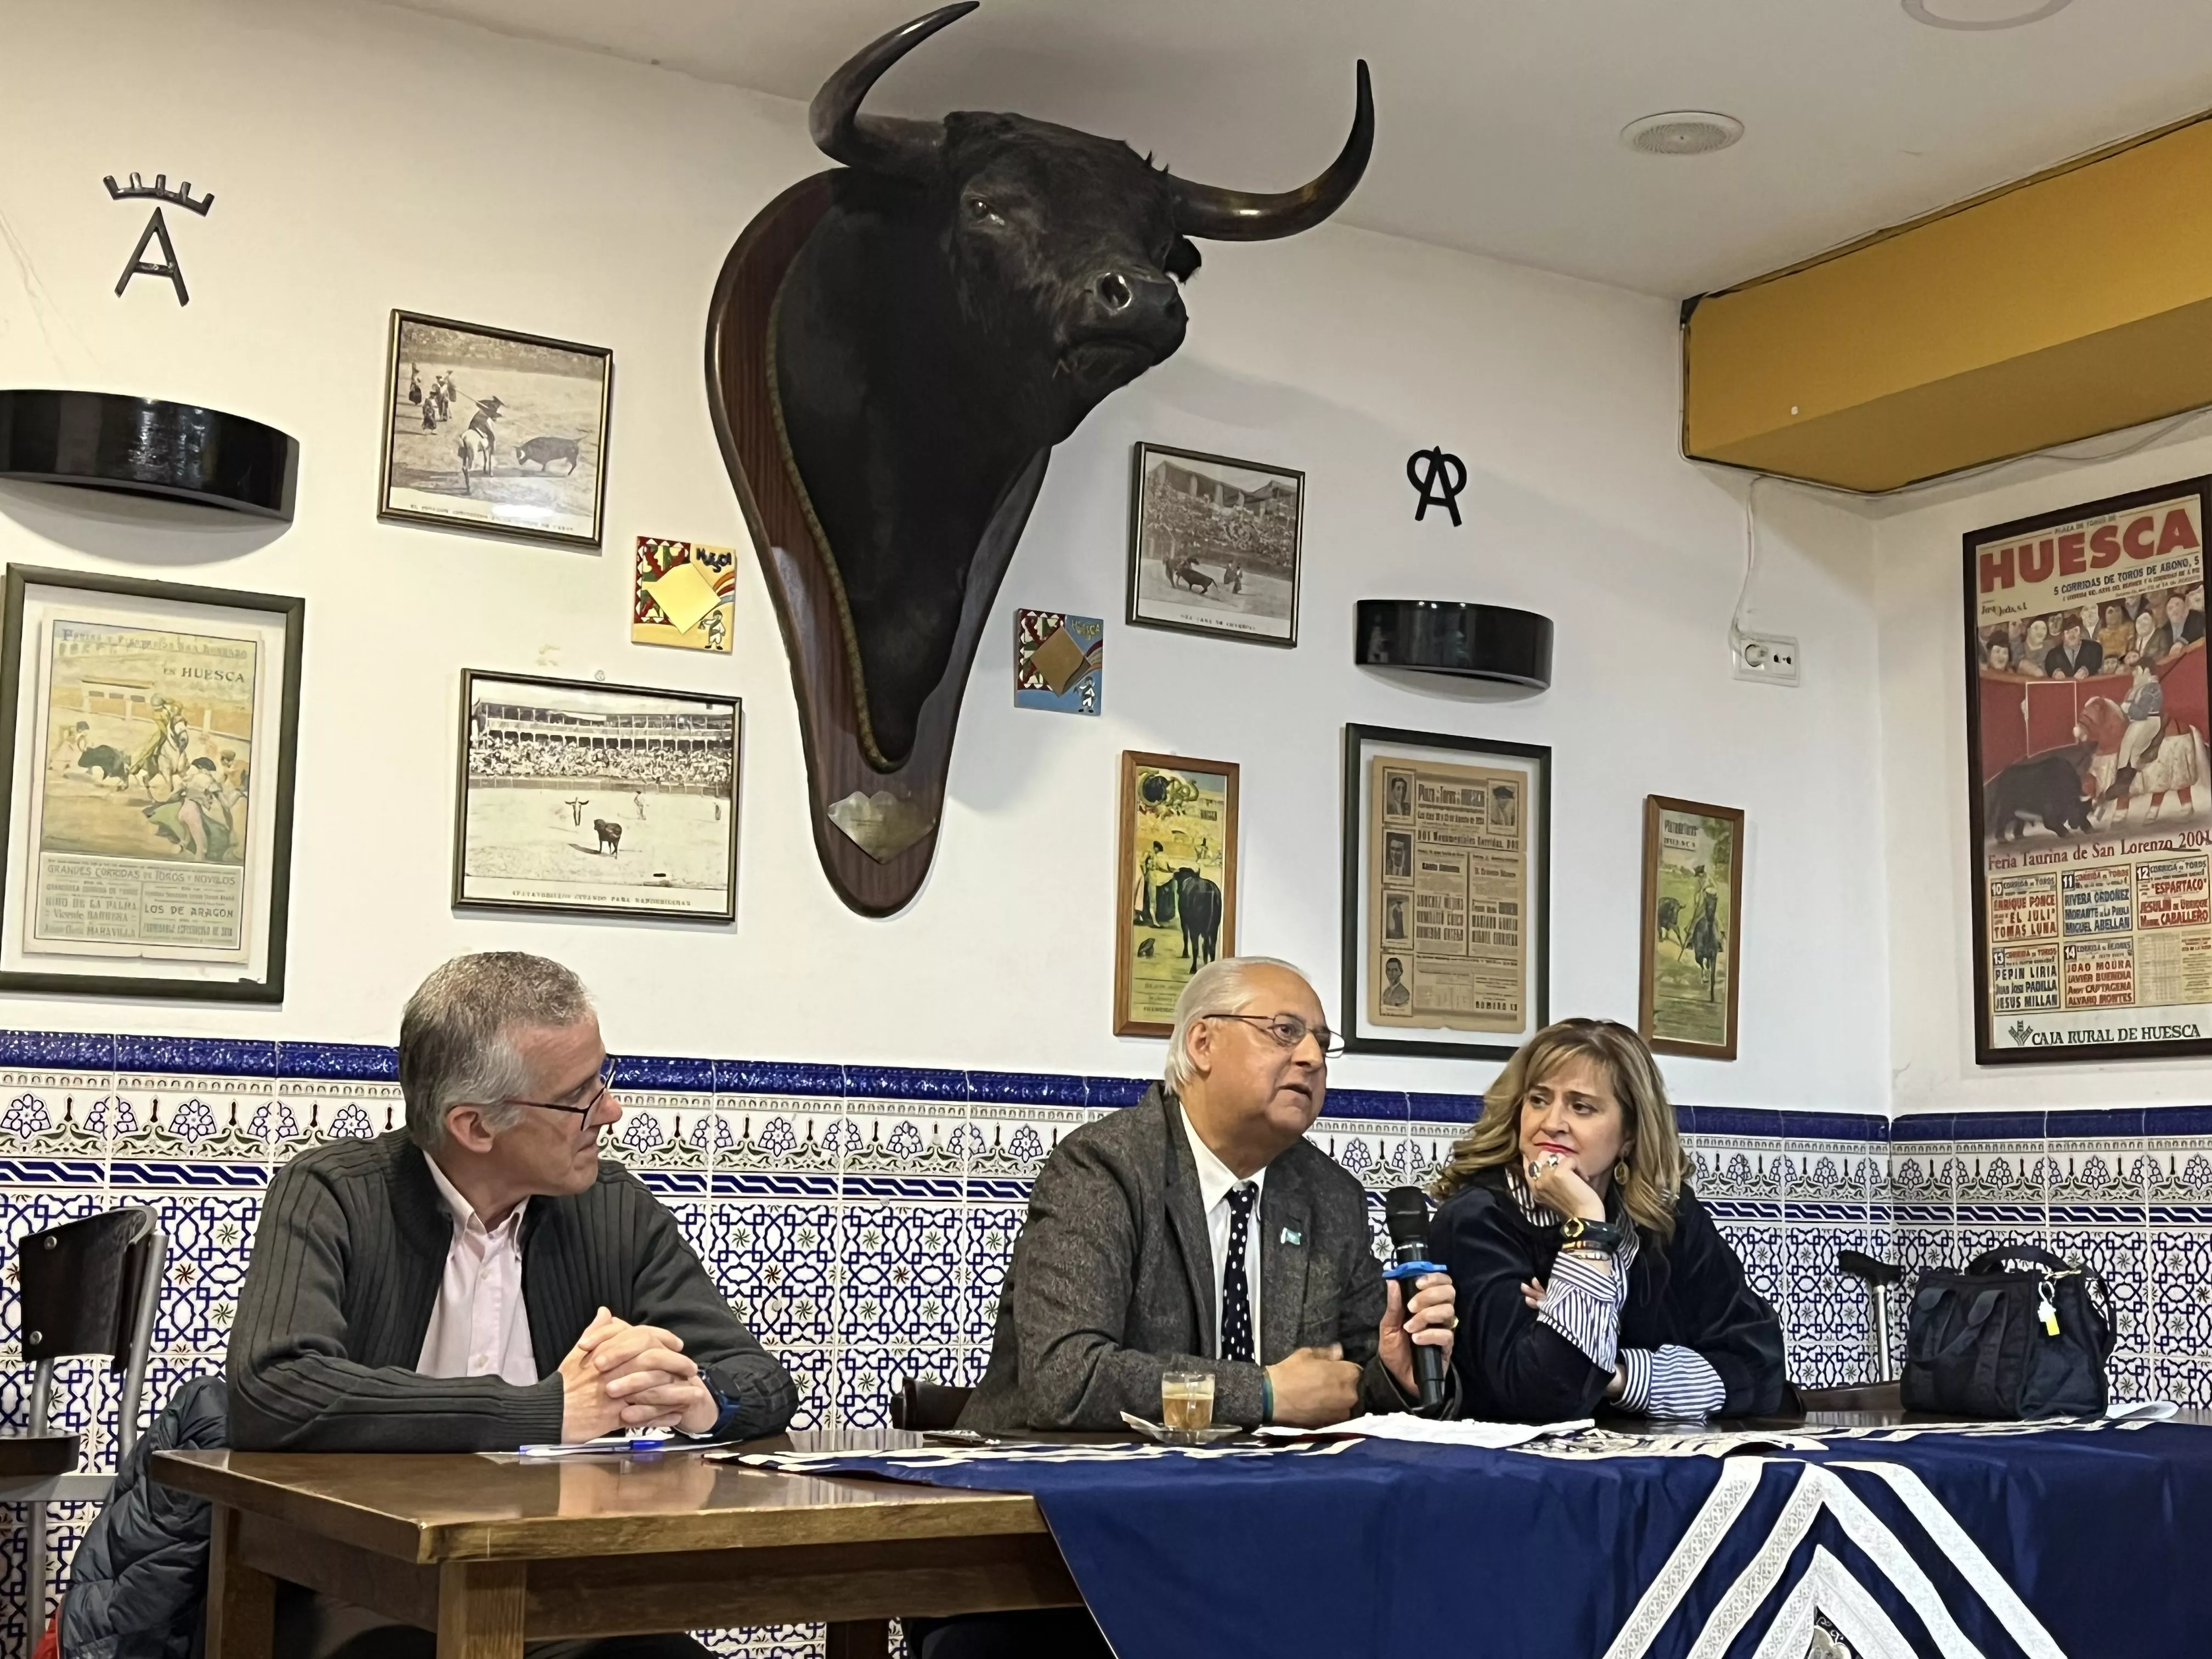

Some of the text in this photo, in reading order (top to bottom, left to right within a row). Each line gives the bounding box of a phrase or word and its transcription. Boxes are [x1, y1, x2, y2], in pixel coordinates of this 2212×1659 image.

[1979, 508, 2200, 593] HUESCA
[2061, 577, 2101, 594] CORRIDAS
[2104, 574, 2115, 585] DE
[2117, 568, 2143, 582] TOROS
[2146, 565, 2157, 575] DE
[181, 667, 244, 683] HUESCA
[1989, 854, 2017, 871] Feria
[2022, 848, 2068, 866] Taurina
[2073, 844, 2088, 860] de
[2091, 842, 2114, 858] San
[2121, 838, 2172, 856] Lorenzo
[48, 864, 92, 876] GRANDES
[95, 867, 141, 879] CORRIDAS
[156, 870, 185, 882] TOROS
[2137, 867, 2149, 879] 12
[2185, 860, 2207, 869] TOROS
[1992, 883, 2002, 895] 10
[2063, 875, 2073, 888] 11
[1994, 894, 2055, 911] ENRIQUE PONCE
[2065, 892, 2091, 906] RIVERA
[144, 904, 233, 918] LOS DE ARAGON
[2160, 910, 2208, 926] CABALLERO
[1994, 921, 2056, 939] TOMAS LUNA
[2094, 917, 2130, 932] ABELLAN
[2065, 946, 2076, 959] 14
[1995, 965, 2057, 981] PEPIN LIRIA
[2067, 960, 2132, 973] JOAO MOURA
[2068, 970, 2131, 983] JAVIER BUENDIA
[2025, 979, 2057, 992] PADILLA
[1996, 994, 2057, 1009] JESUS MILLAN
[2068, 993, 2132, 1006] ALVARO MONTES
[2032, 1024, 2201, 1046] CAJA RURAL DE HUESCA
